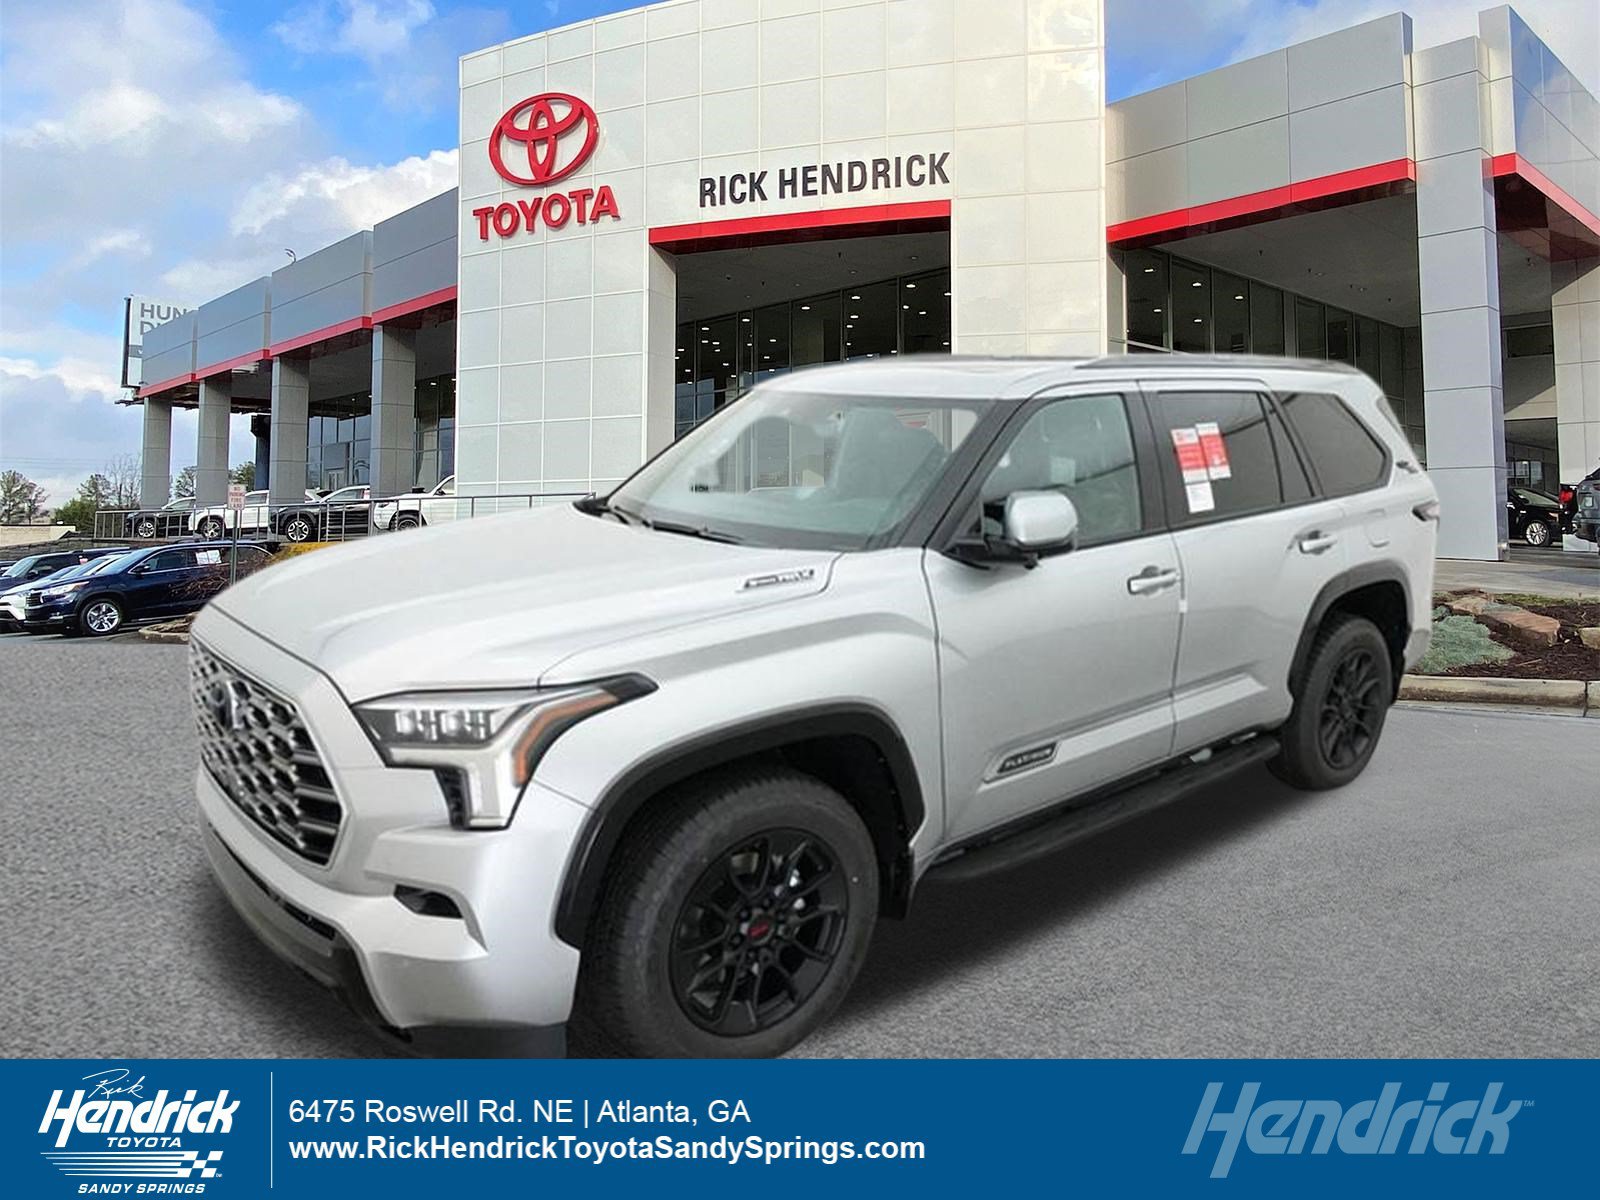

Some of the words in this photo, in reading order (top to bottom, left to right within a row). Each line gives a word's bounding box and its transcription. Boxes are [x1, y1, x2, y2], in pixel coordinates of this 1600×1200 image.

[699, 170, 769, 208] RICK
[778, 152, 950, 200] HENDRICK
[472, 185, 621, 241] TOYOTA
